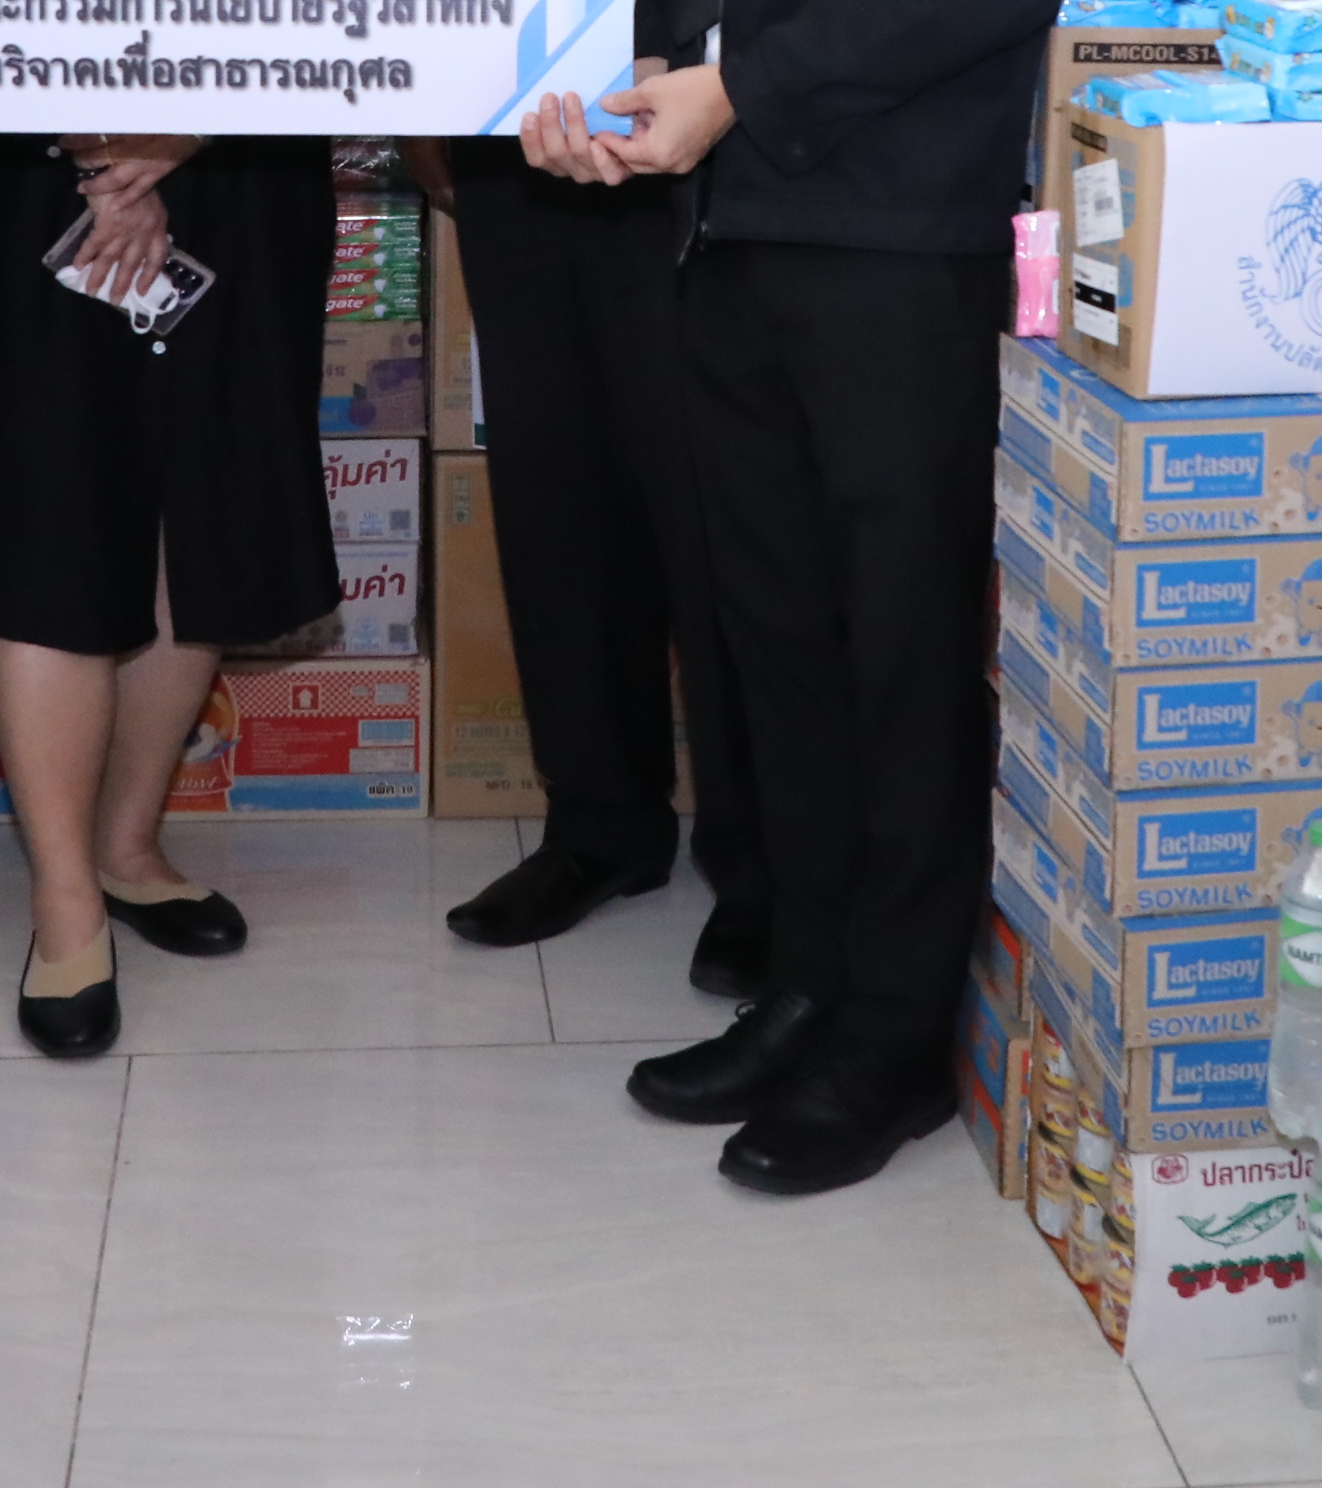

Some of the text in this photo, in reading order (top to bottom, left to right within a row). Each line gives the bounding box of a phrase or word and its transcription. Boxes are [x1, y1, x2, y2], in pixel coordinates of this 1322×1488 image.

[326, 296, 364, 311] gate
[1148, 443, 1260, 493] Lactasoy
[1143, 508, 1261, 534] SOYMILK
[339, 564, 406, 602] มค่า
[1142, 572, 1252, 619] Lactasoy
[1137, 634, 1253, 660] SOYMILK
[1142, 692, 1253, 743] Lactasoy
[1137, 755, 1253, 782] SOYMILK
[1143, 822, 1254, 871] Lactasoy
[1137, 883, 1253, 910] SOYMILK
[1152, 951, 1260, 1000] Lactasoy
[1147, 1009, 1261, 1039] SOYMILK
[1157, 1052, 1269, 1105] Lactasoy
[1151, 1116, 1268, 1143] SOYMILK
